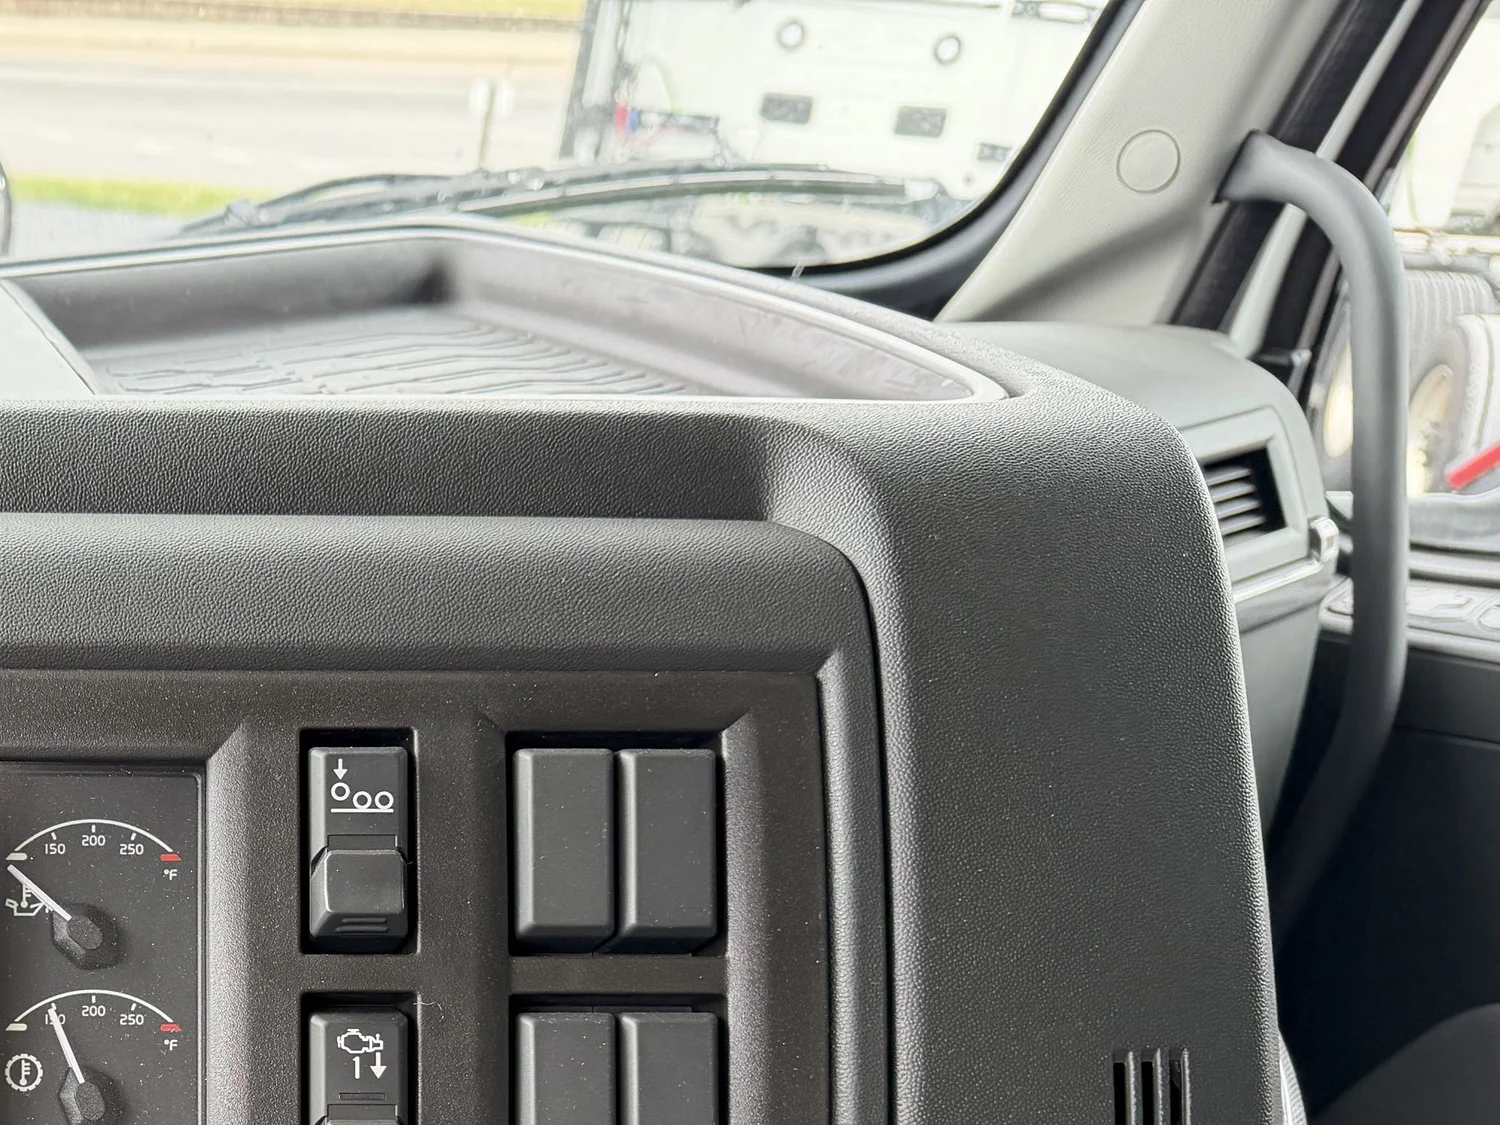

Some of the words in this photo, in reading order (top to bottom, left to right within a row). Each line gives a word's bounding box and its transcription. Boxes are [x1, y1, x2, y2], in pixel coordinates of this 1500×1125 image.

[81, 835, 106, 847] 200
[44, 843, 66, 855] 150
[119, 843, 144, 855] 250
[81, 1005, 106, 1018] 200
[44, 1013, 66, 1025] 10
[119, 1014, 144, 1026] 250
